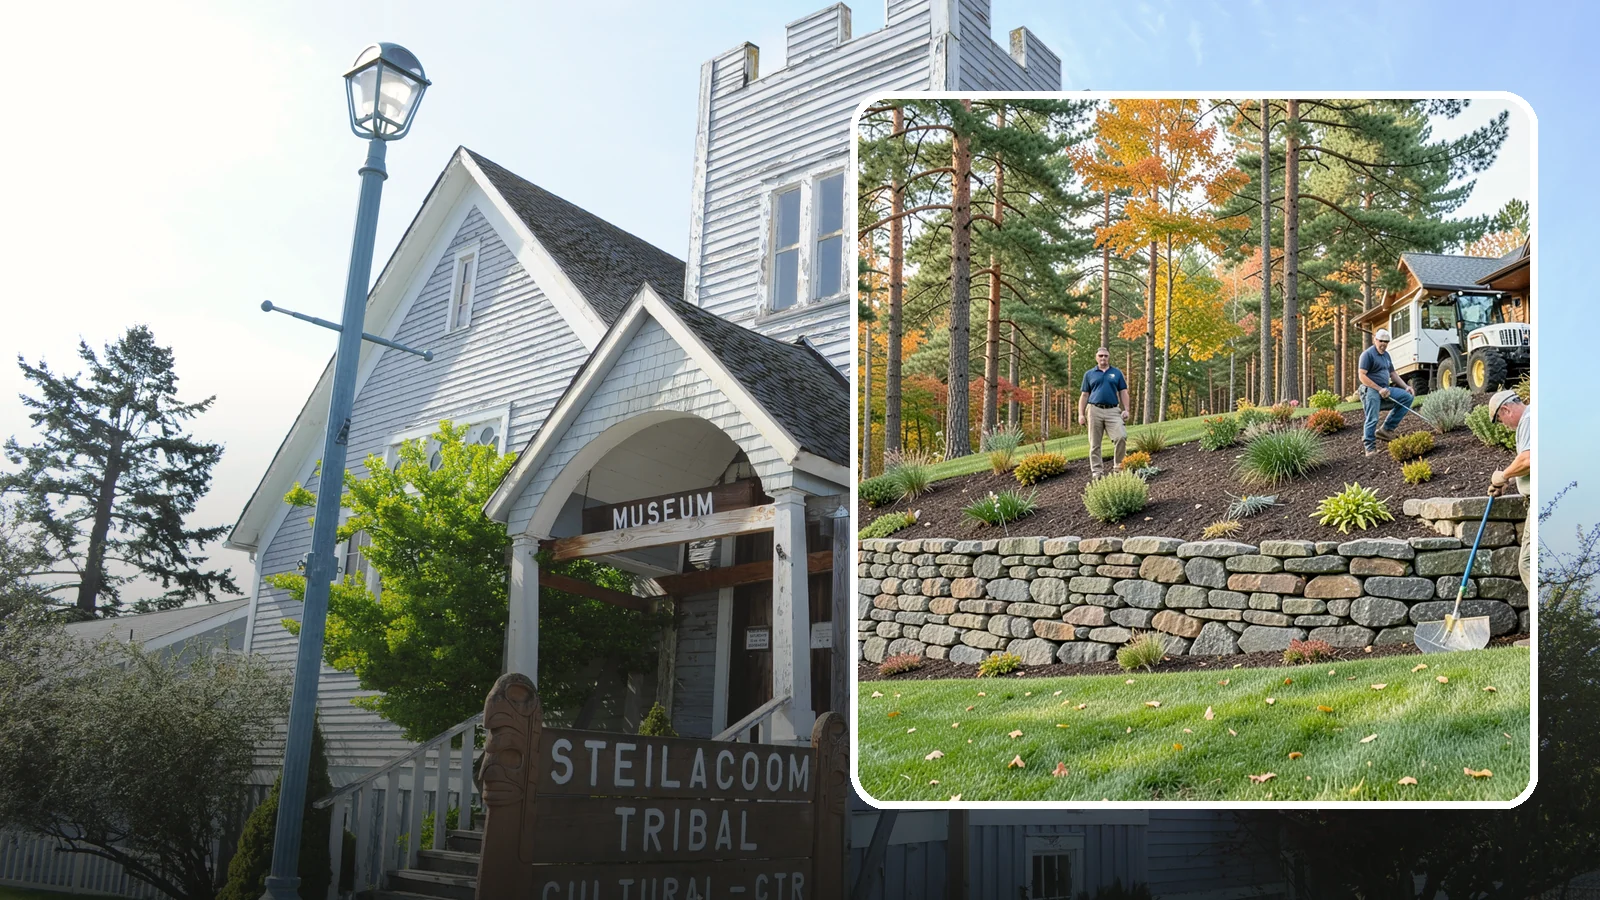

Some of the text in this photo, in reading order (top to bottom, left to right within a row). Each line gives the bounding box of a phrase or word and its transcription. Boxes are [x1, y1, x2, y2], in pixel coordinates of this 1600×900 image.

[613, 491, 713, 530] MUSEUM
[551, 738, 809, 792] STEILACOOM
[615, 807, 757, 850] TRIBAL
